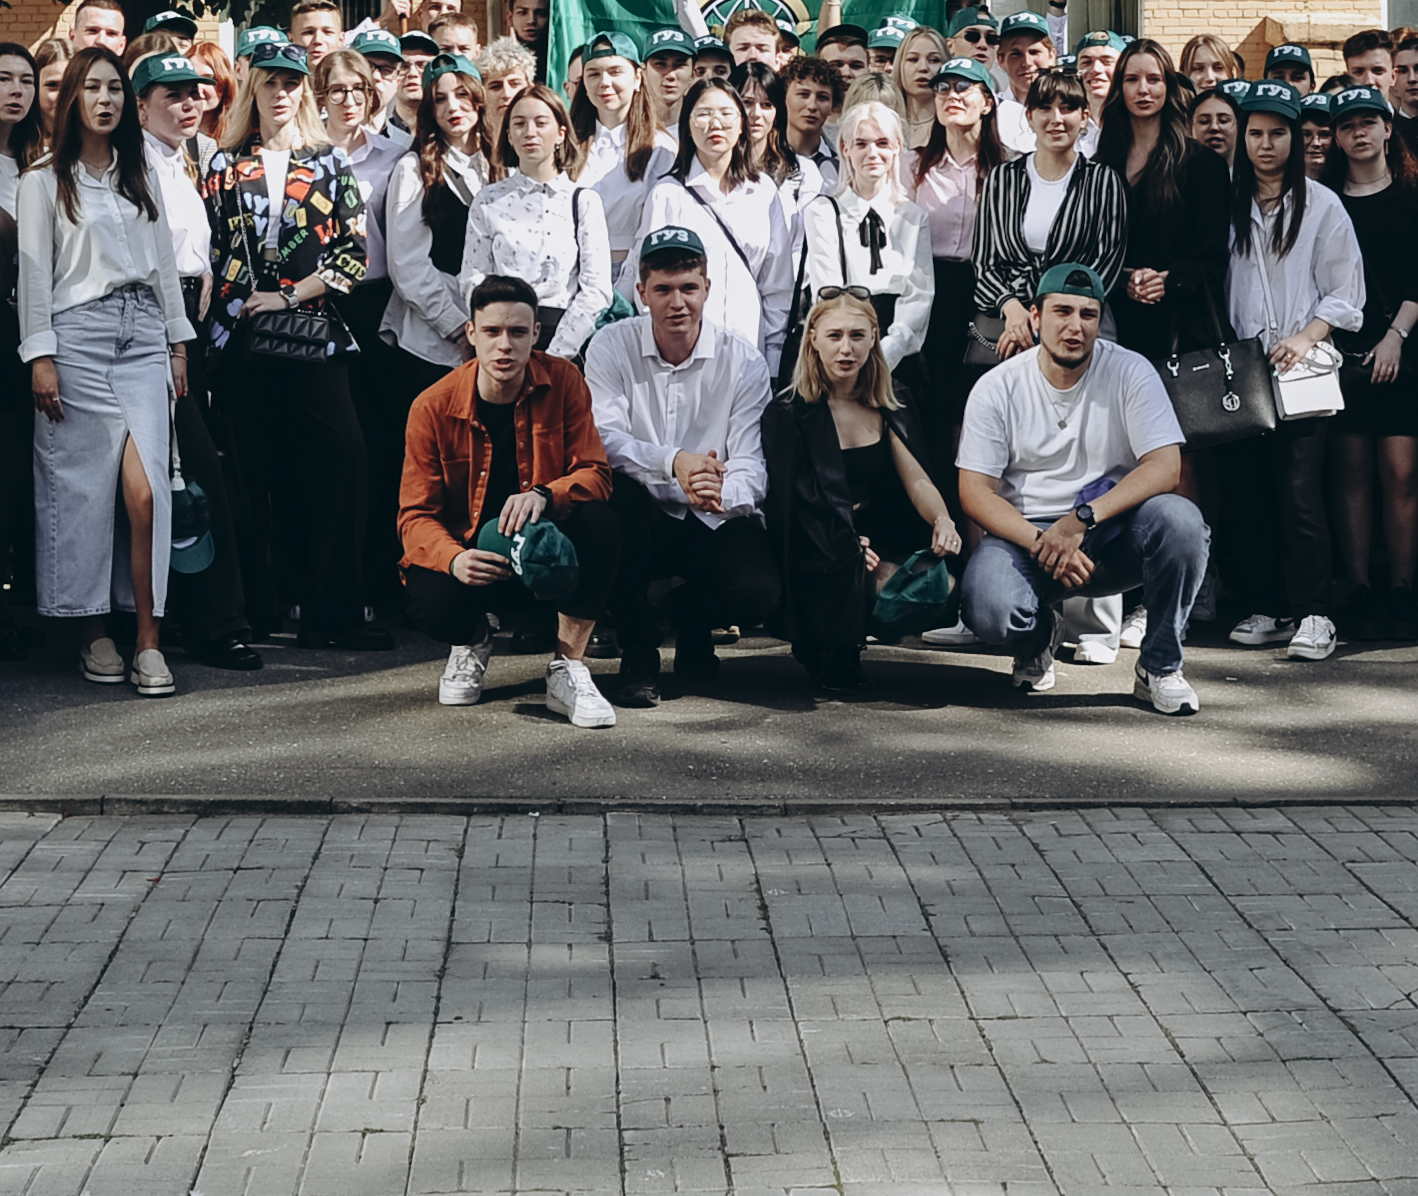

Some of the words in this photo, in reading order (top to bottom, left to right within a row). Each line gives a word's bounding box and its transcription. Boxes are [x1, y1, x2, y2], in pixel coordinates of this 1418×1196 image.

[652, 29, 684, 45] ГУЗ
[1273, 45, 1303, 57] ГУЗ
[1256, 83, 1291, 101] ГУЗ
[1336, 88, 1371, 105] ГУЗ
[650, 228, 690, 245] ГУЗ
